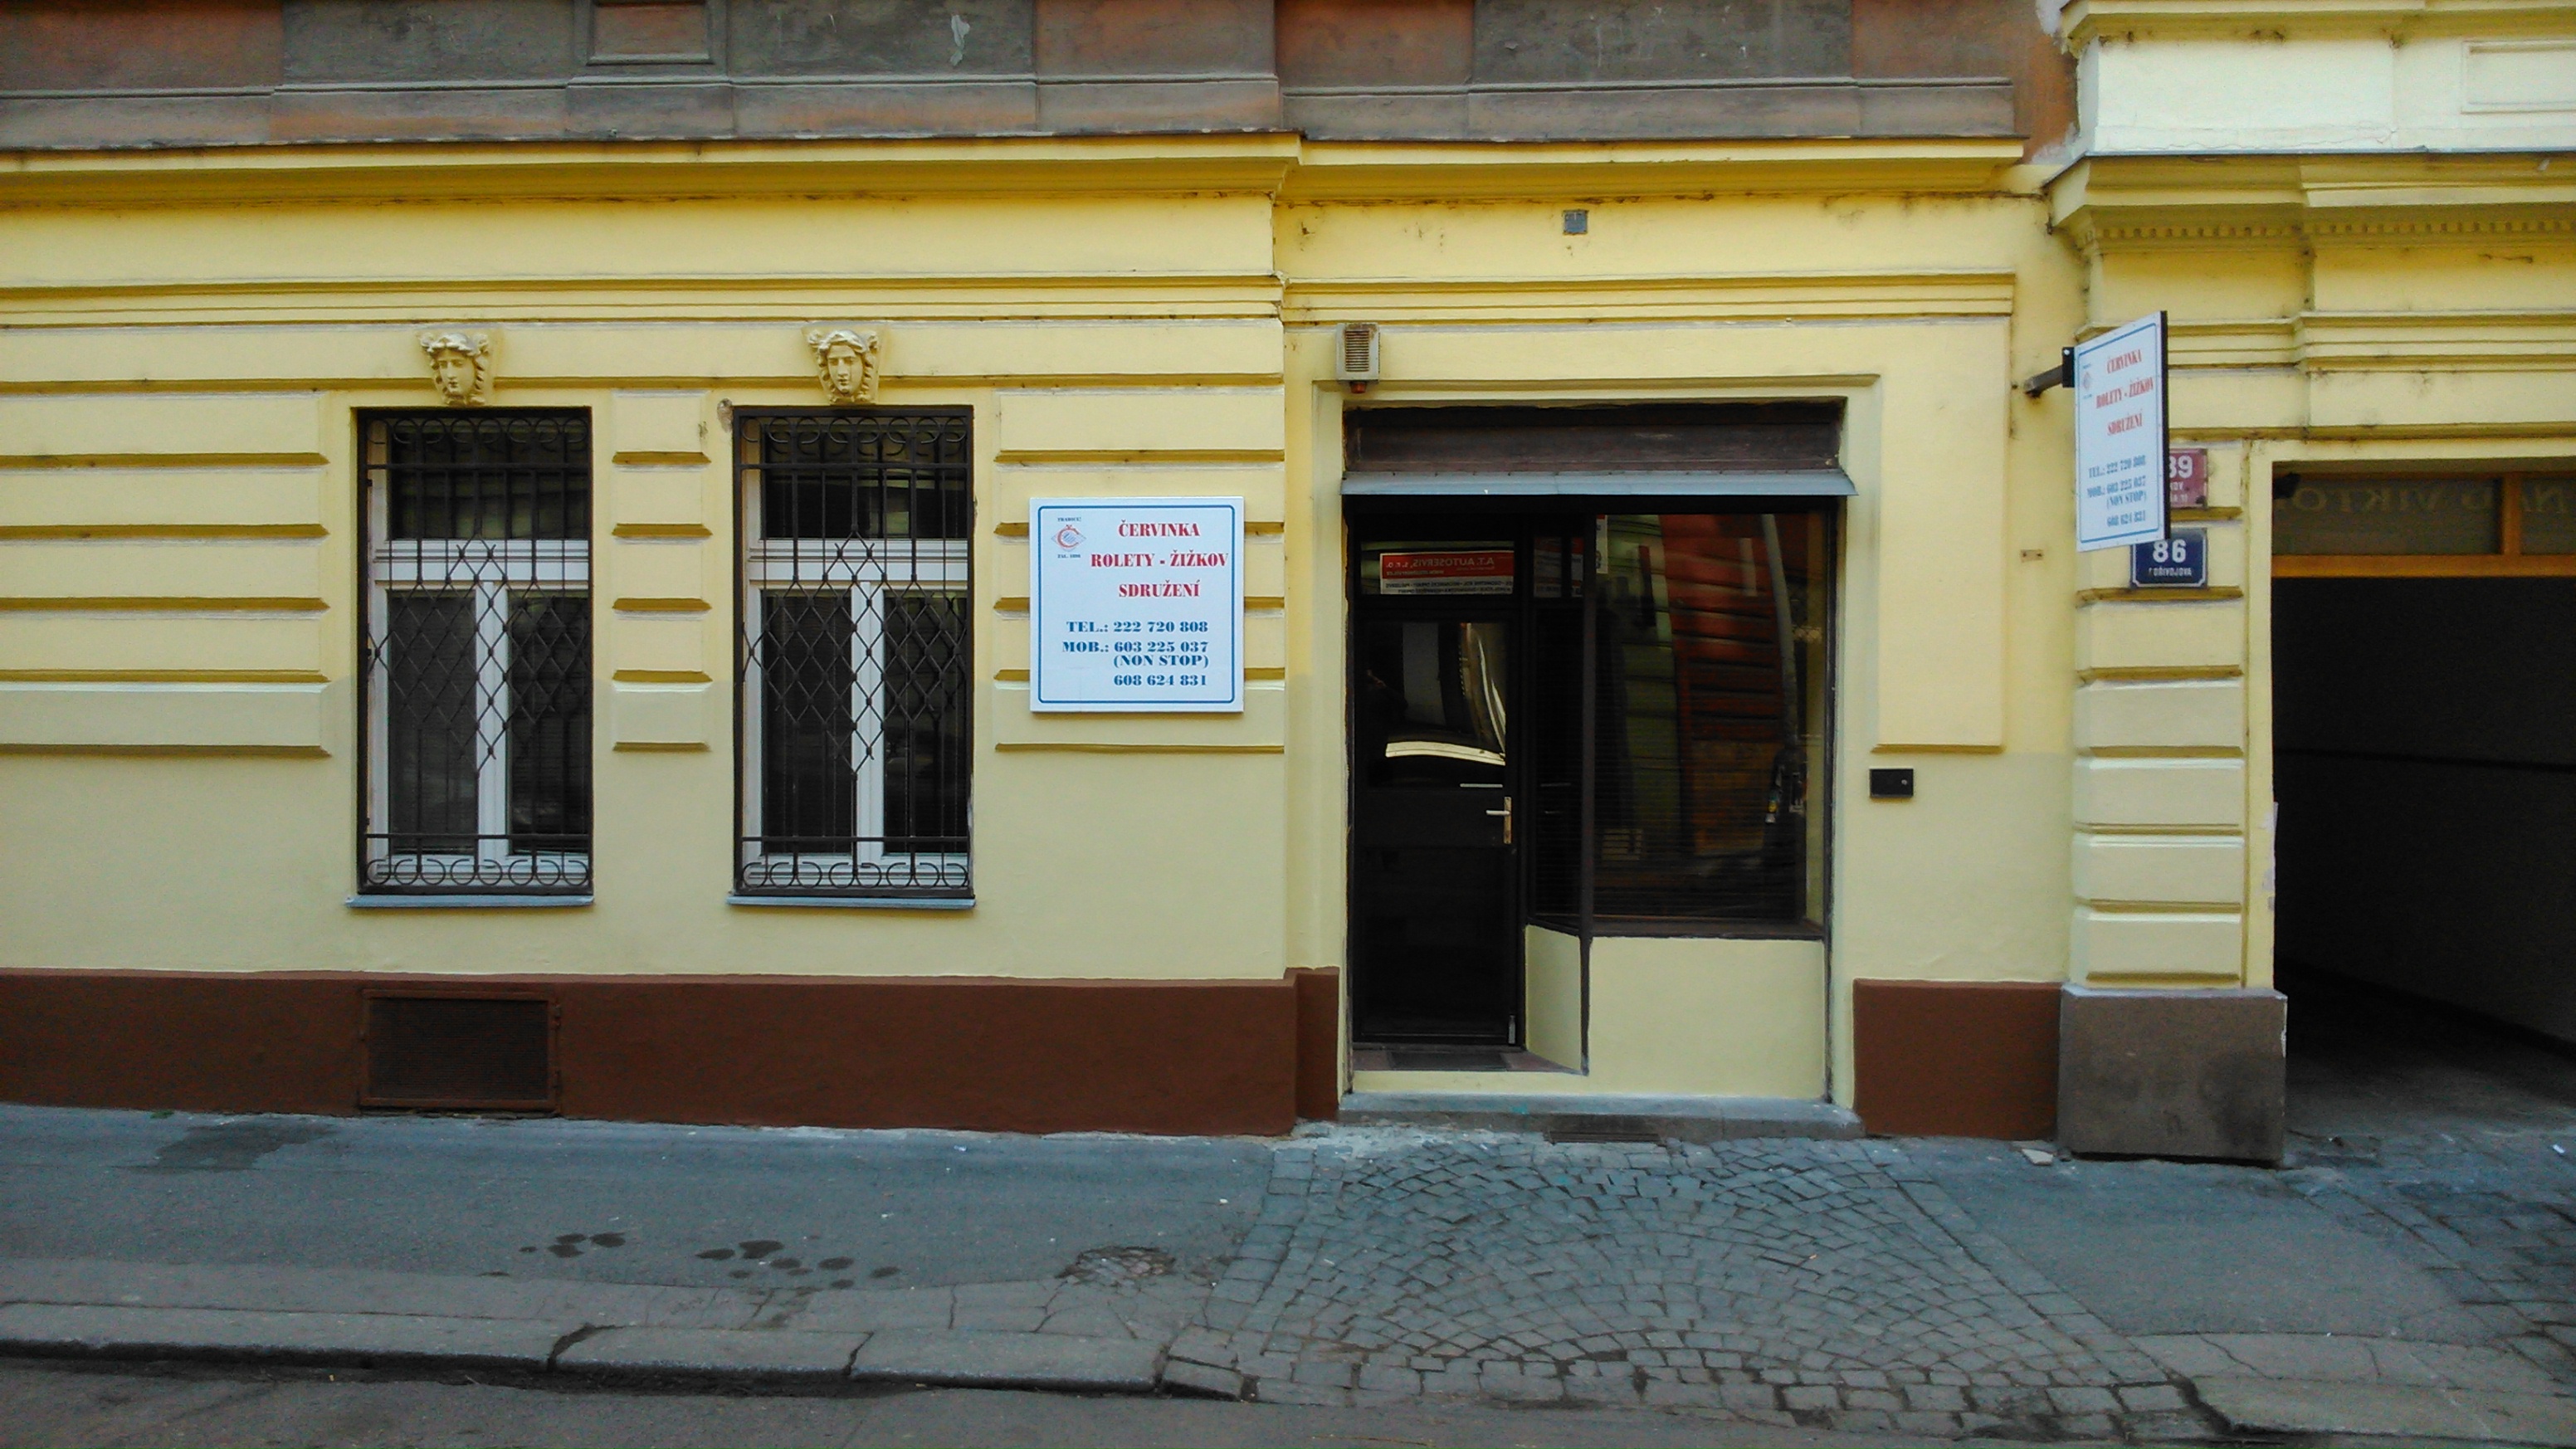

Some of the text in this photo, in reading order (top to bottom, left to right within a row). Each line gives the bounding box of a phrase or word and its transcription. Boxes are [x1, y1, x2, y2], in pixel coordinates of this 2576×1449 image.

[1118, 520, 1200, 536] ČERVINKA
[1090, 554, 1155, 567] ROLETY
[1170, 549, 1228, 567] ŽIŽKOV
[2153, 539, 2186, 563] 86
[1119, 579, 1201, 597] SDRUŽENÍ
[1066, 621, 1208, 632] TEL.: 222 720 808
[1062, 641, 1209, 652] MOB.: 603 225 037
[1114, 654, 1209, 668] (NON STOP)
[1114, 675, 1207, 686] 608 624 831
